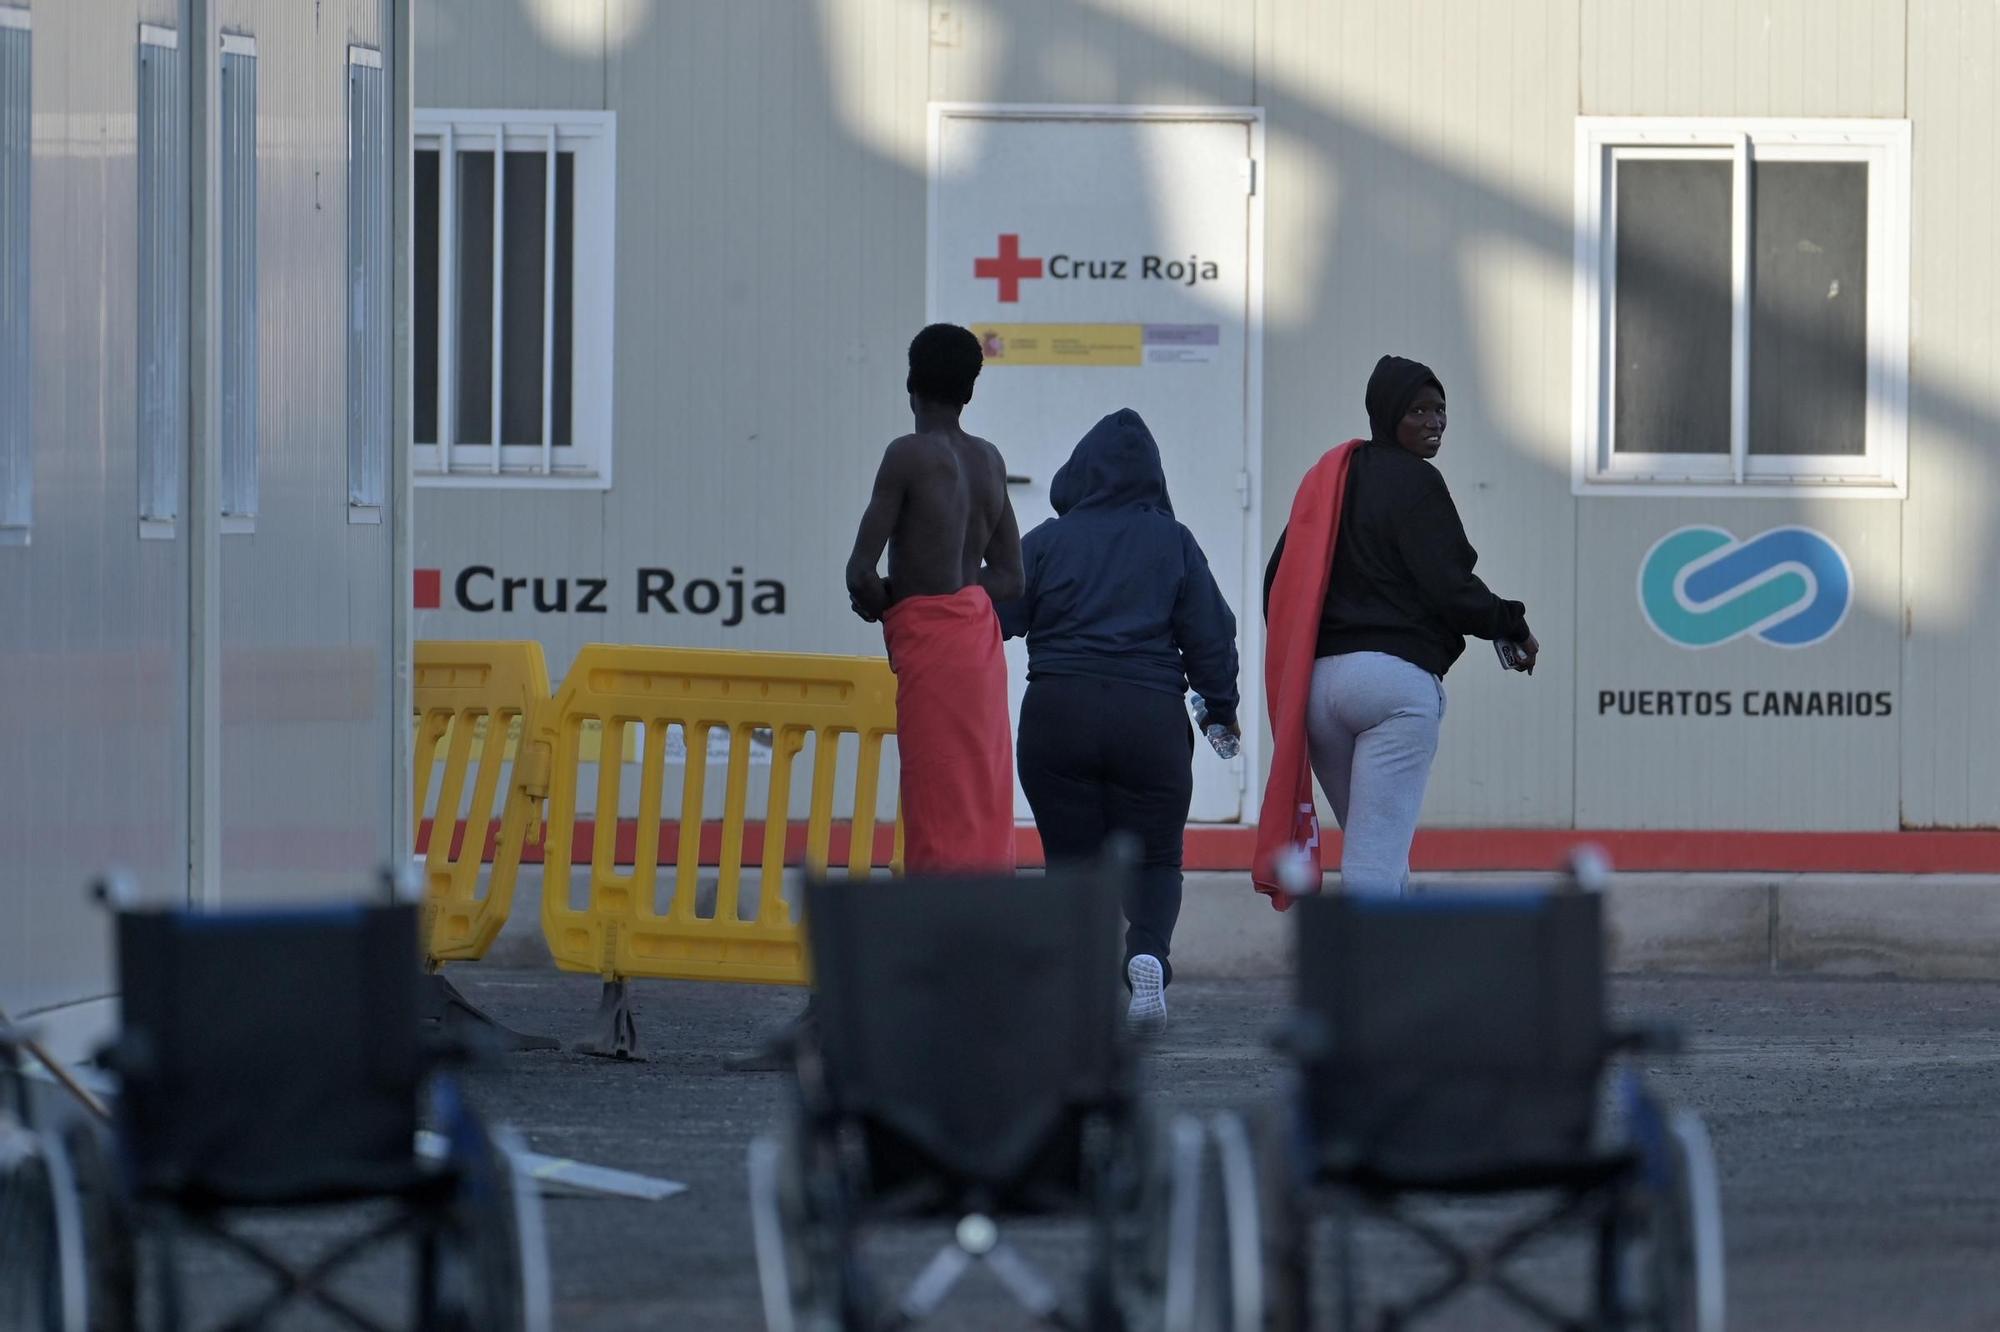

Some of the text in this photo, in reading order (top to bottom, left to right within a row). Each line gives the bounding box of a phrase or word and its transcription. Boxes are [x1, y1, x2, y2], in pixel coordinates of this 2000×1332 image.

[1048, 254, 1219, 286] Cruz Roja
[454, 565, 787, 627] Cruz Roja
[1599, 690, 1892, 716] PUERTOS CANARIOS
